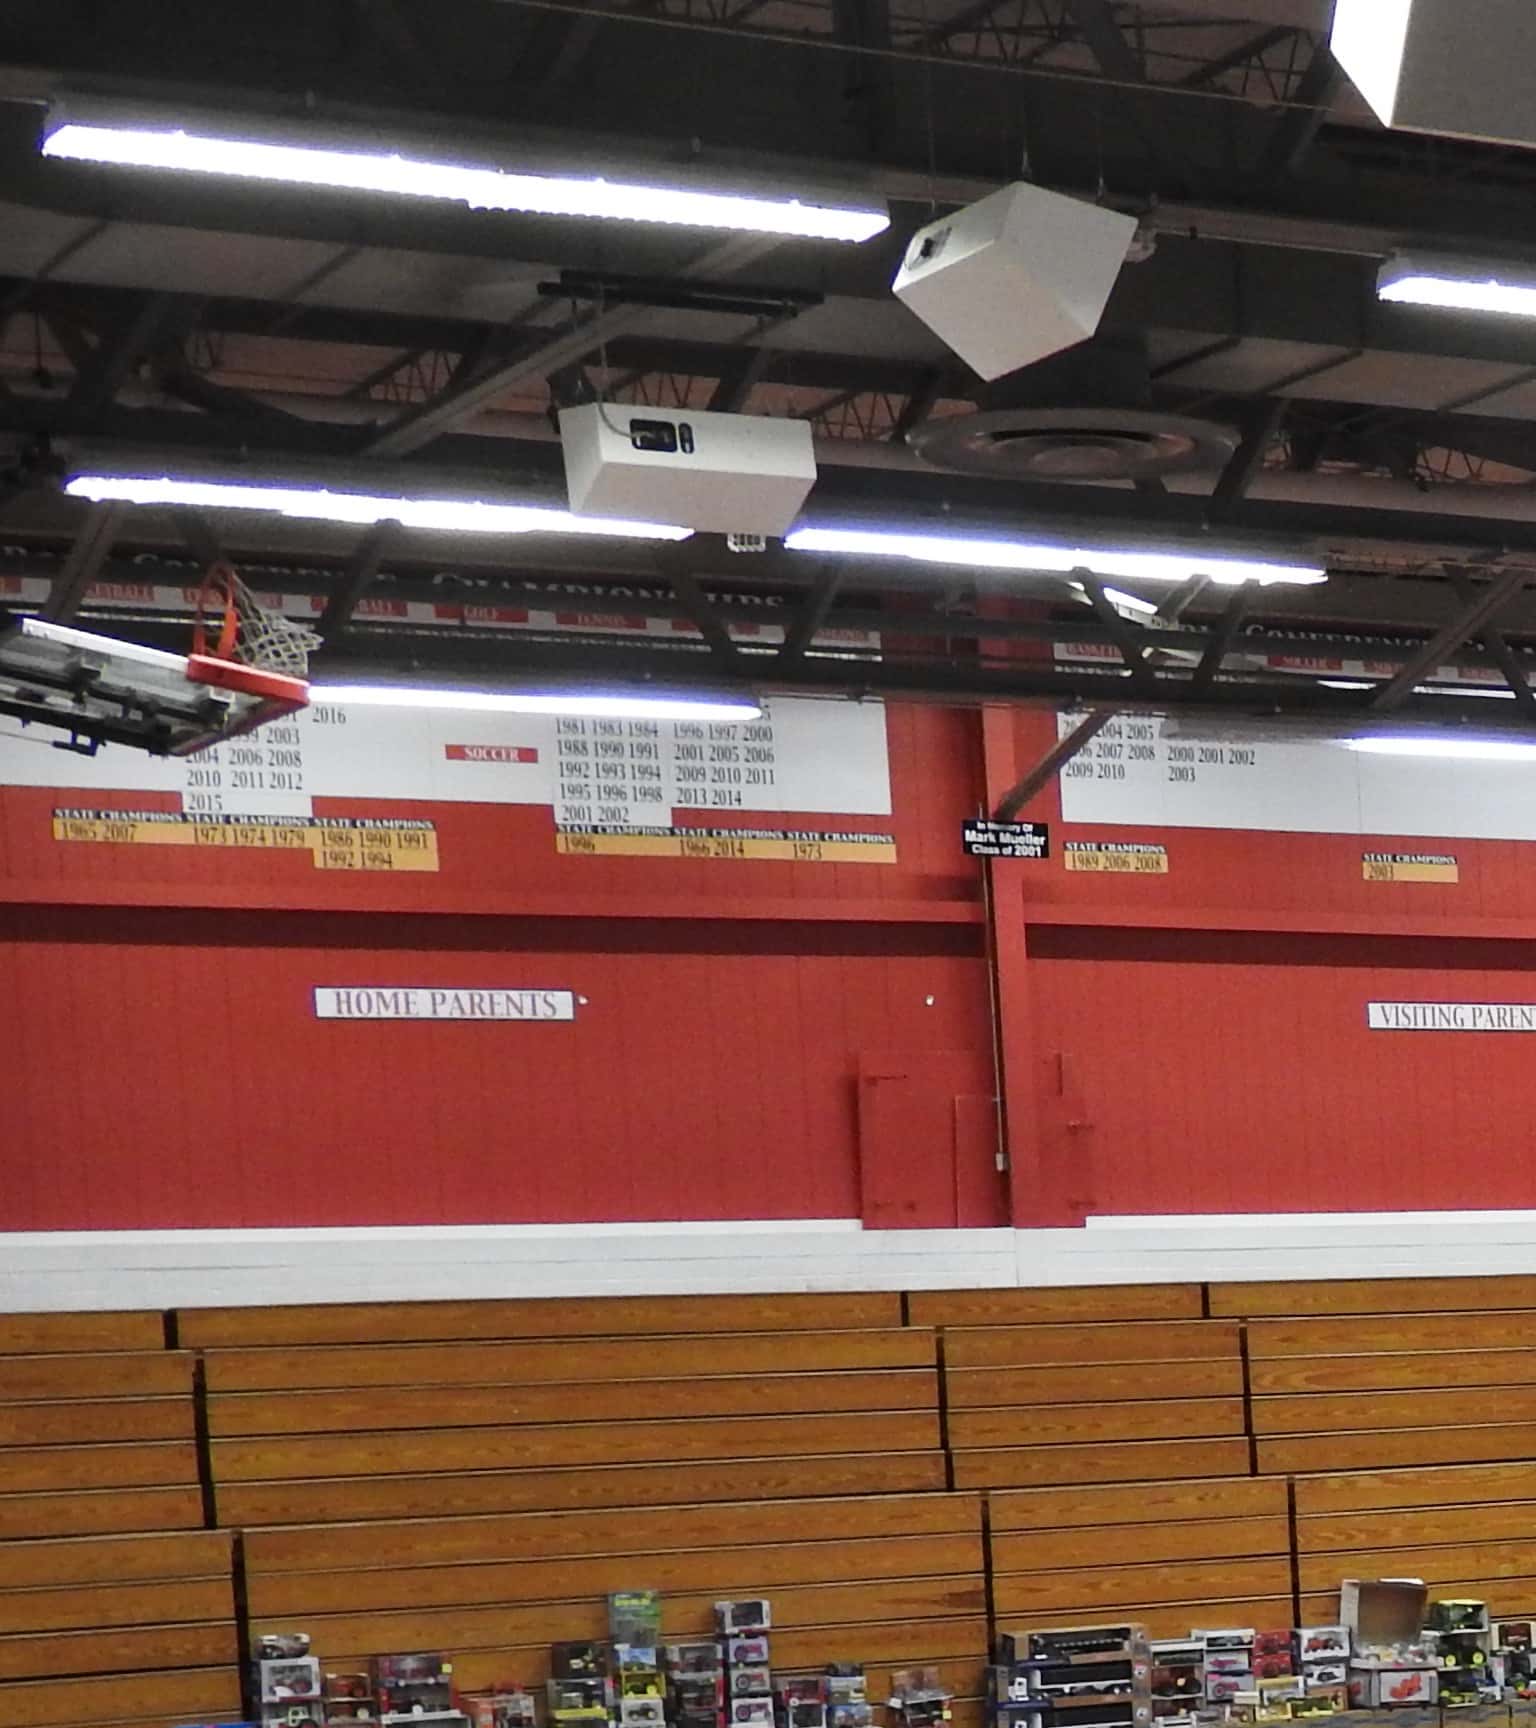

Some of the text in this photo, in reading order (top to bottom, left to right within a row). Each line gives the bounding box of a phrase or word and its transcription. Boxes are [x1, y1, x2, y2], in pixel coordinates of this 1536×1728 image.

[312, 707, 346, 725] 2016
[743, 724, 773, 742] 2000
[1127, 724, 1154, 740] 2005
[229, 749, 302, 768] 2006 2008
[463, 746, 520, 762] SOCCER
[629, 742, 659, 760] 1991
[674, 743, 775, 763] 2001 2005 2006
[1097, 744, 1155, 760] 2007 2008
[1168, 747, 1255, 765] 2000 2001 2002
[559, 761, 590, 779] 1992
[675, 765, 775, 785] 2009 2010 2011
[1066, 763, 1125, 779] 2009 2010
[1168, 766, 1195, 782] 2003
[188, 770, 303, 790] 2010 2011 2012
[560, 783, 591, 800] 1995
[676, 787, 742, 806] 2013 2014
[188, 794, 222, 811] 2015
[562, 805, 630, 824] 2001 2002
[965, 831, 1046, 846] Mark Mueller
[972, 845, 1000, 855] Class
[1014, 845, 1042, 858] 2001
[335, 990, 558, 1019] HOME PARENTS
[1380, 1005, 1465, 1028] VISITING
